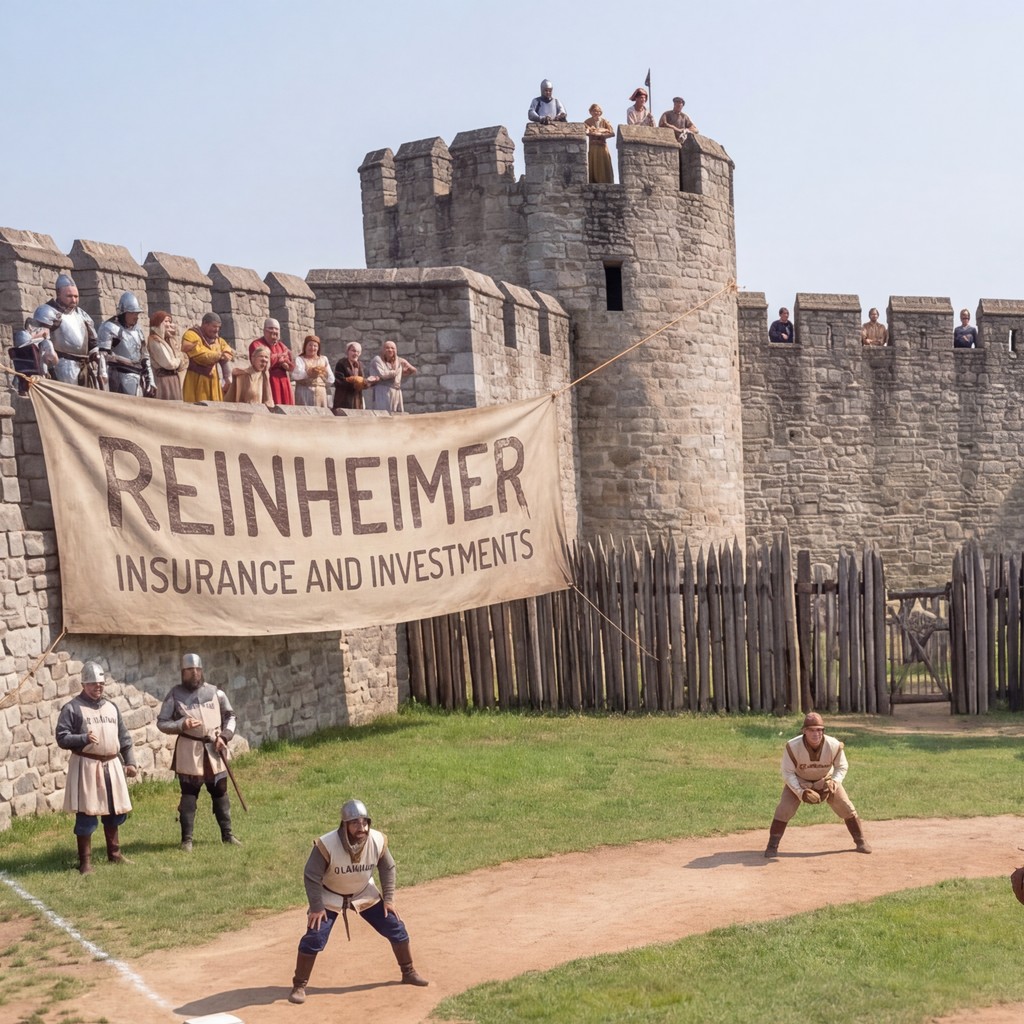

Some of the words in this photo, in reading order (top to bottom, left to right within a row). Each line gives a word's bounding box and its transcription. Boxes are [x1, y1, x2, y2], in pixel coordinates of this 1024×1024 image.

[98, 436, 531, 537] REINHEIMER
[115, 554, 298, 595] INSURANCE
[306, 557, 362, 593] AND
[370, 529, 534, 588] INVESTMENTS
